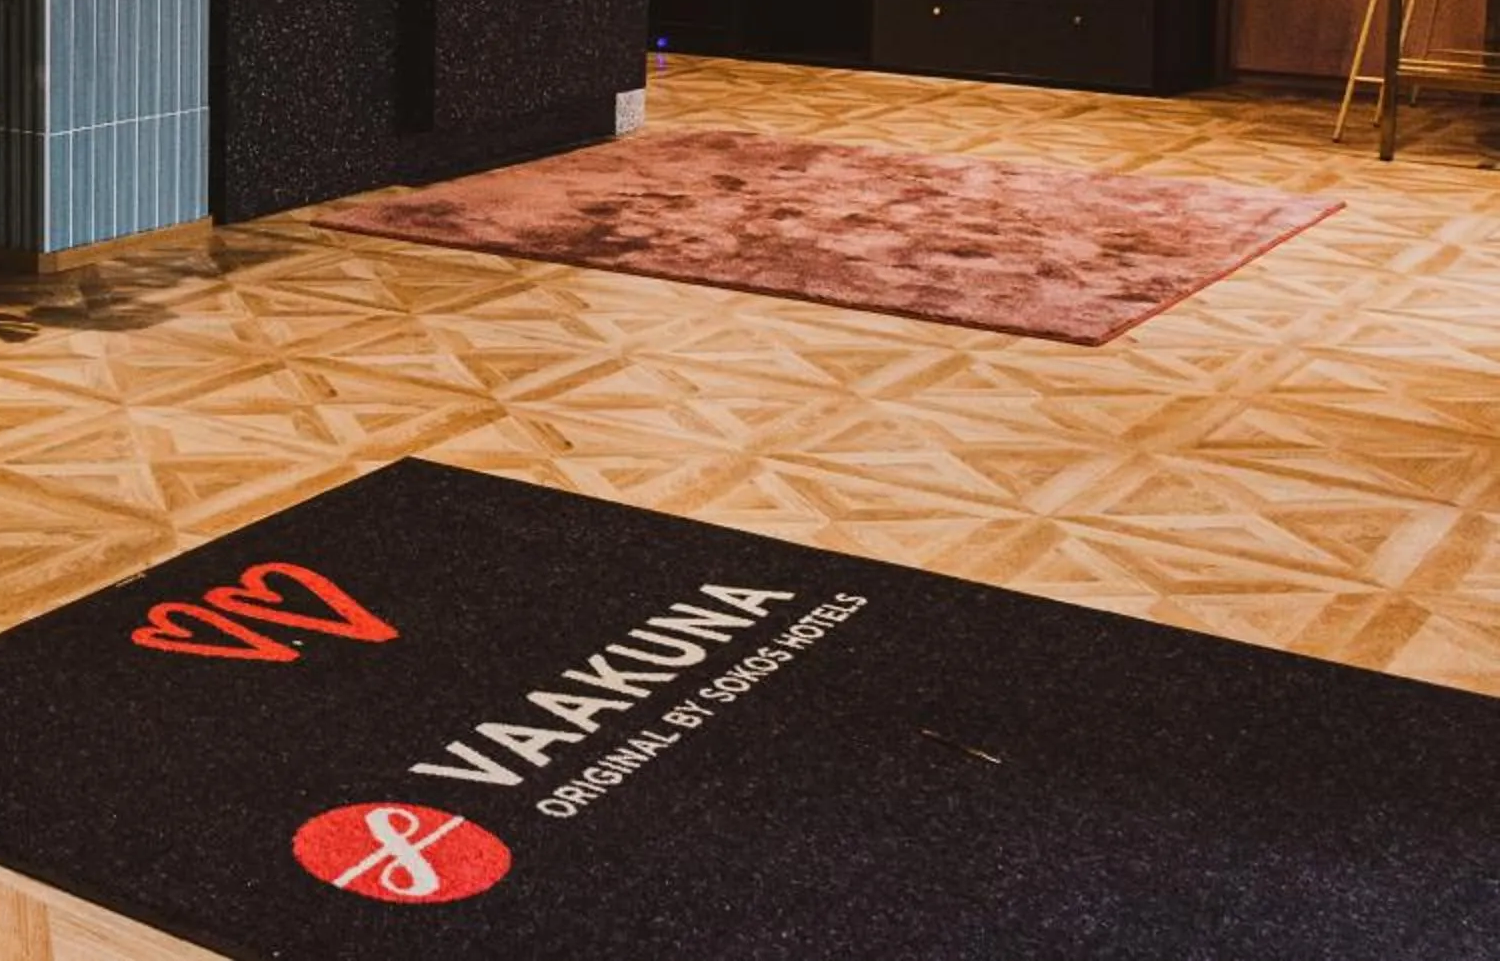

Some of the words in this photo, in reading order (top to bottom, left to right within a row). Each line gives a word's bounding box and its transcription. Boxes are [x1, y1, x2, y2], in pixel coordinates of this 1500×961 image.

[409, 583, 795, 787] VAAKUNA
[536, 727, 681, 819] ORIGINAL
[662, 699, 715, 729] BY
[698, 647, 793, 703] SOKOS
[776, 592, 868, 650] HOTELS
